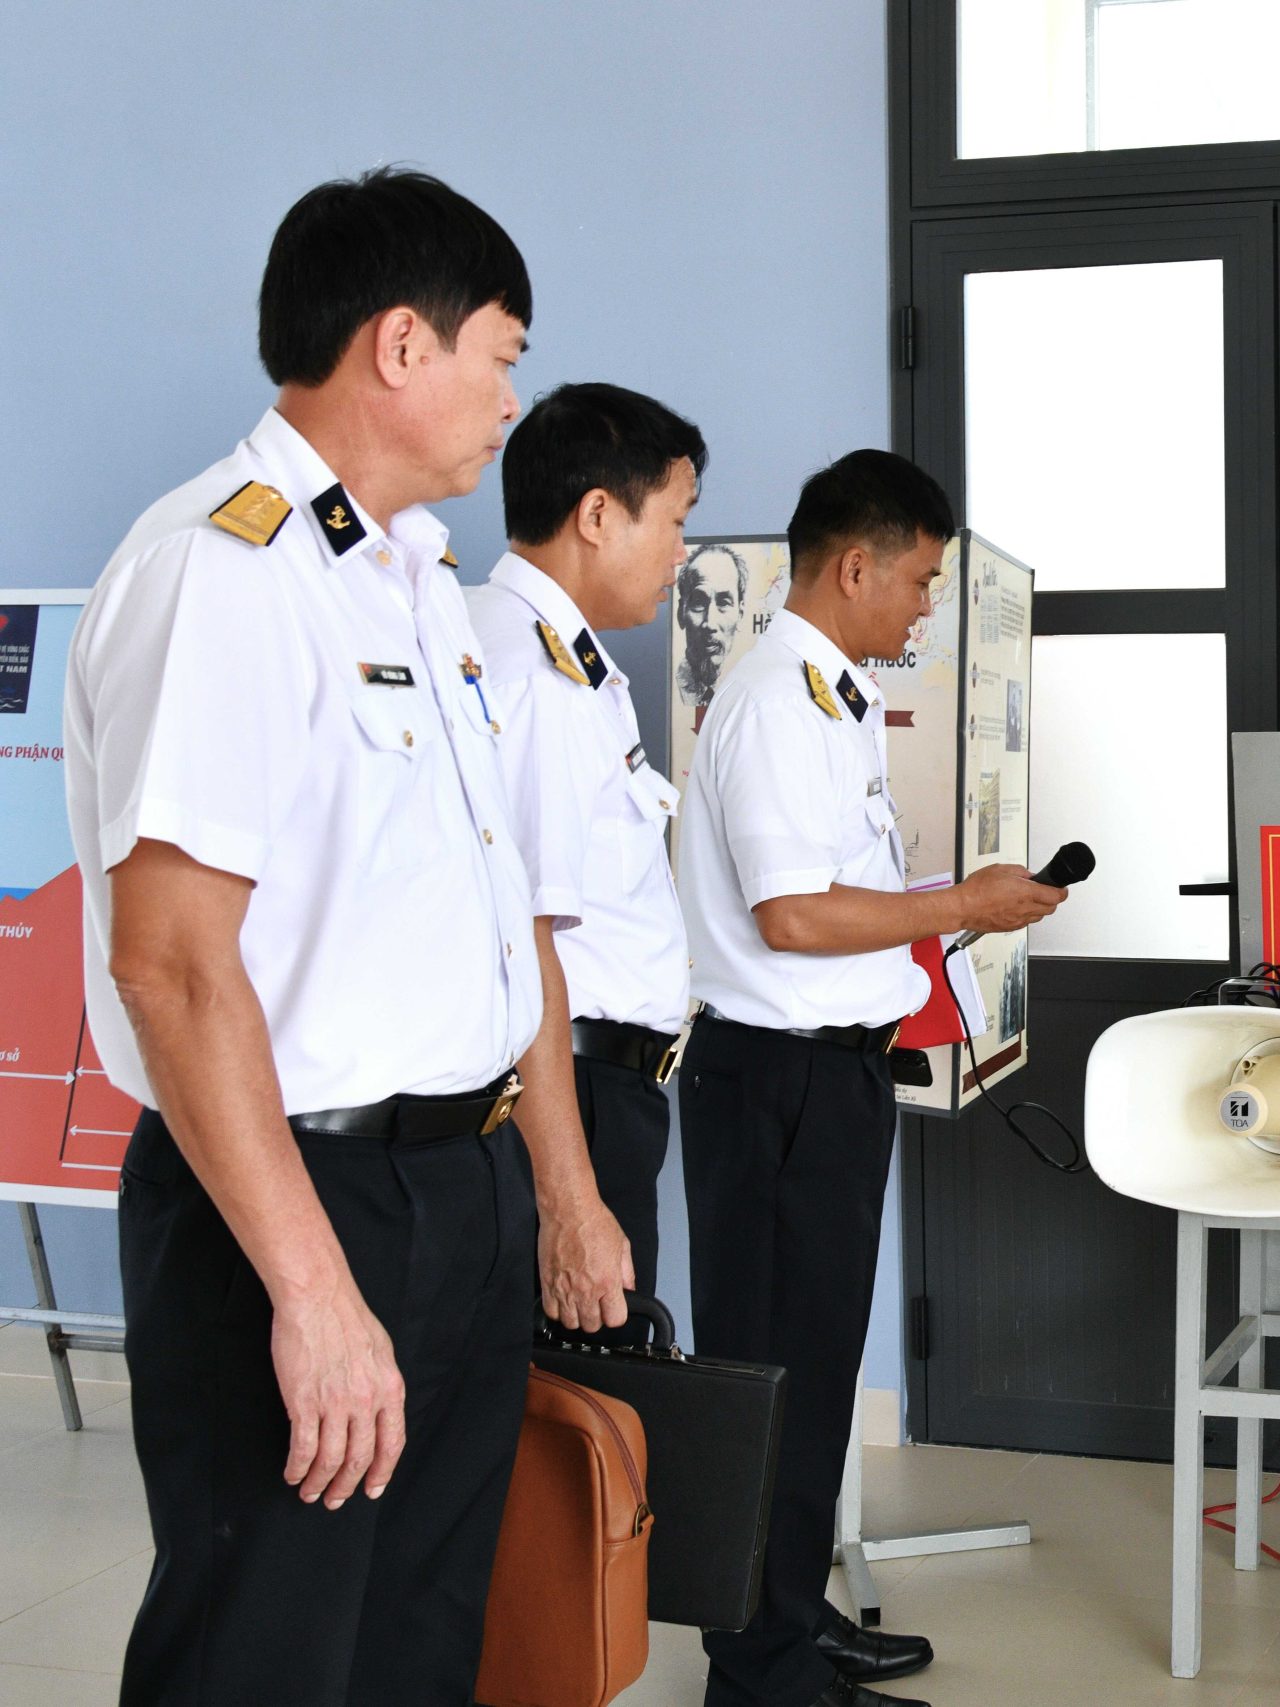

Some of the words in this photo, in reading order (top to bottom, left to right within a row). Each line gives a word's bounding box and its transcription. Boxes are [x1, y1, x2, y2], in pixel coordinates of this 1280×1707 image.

[6, 665, 28, 673] NAM
[15, 744, 49, 762] PHẬN
[0, 922, 33, 938] THỦY
[1231, 1119, 1249, 1127] TOA
